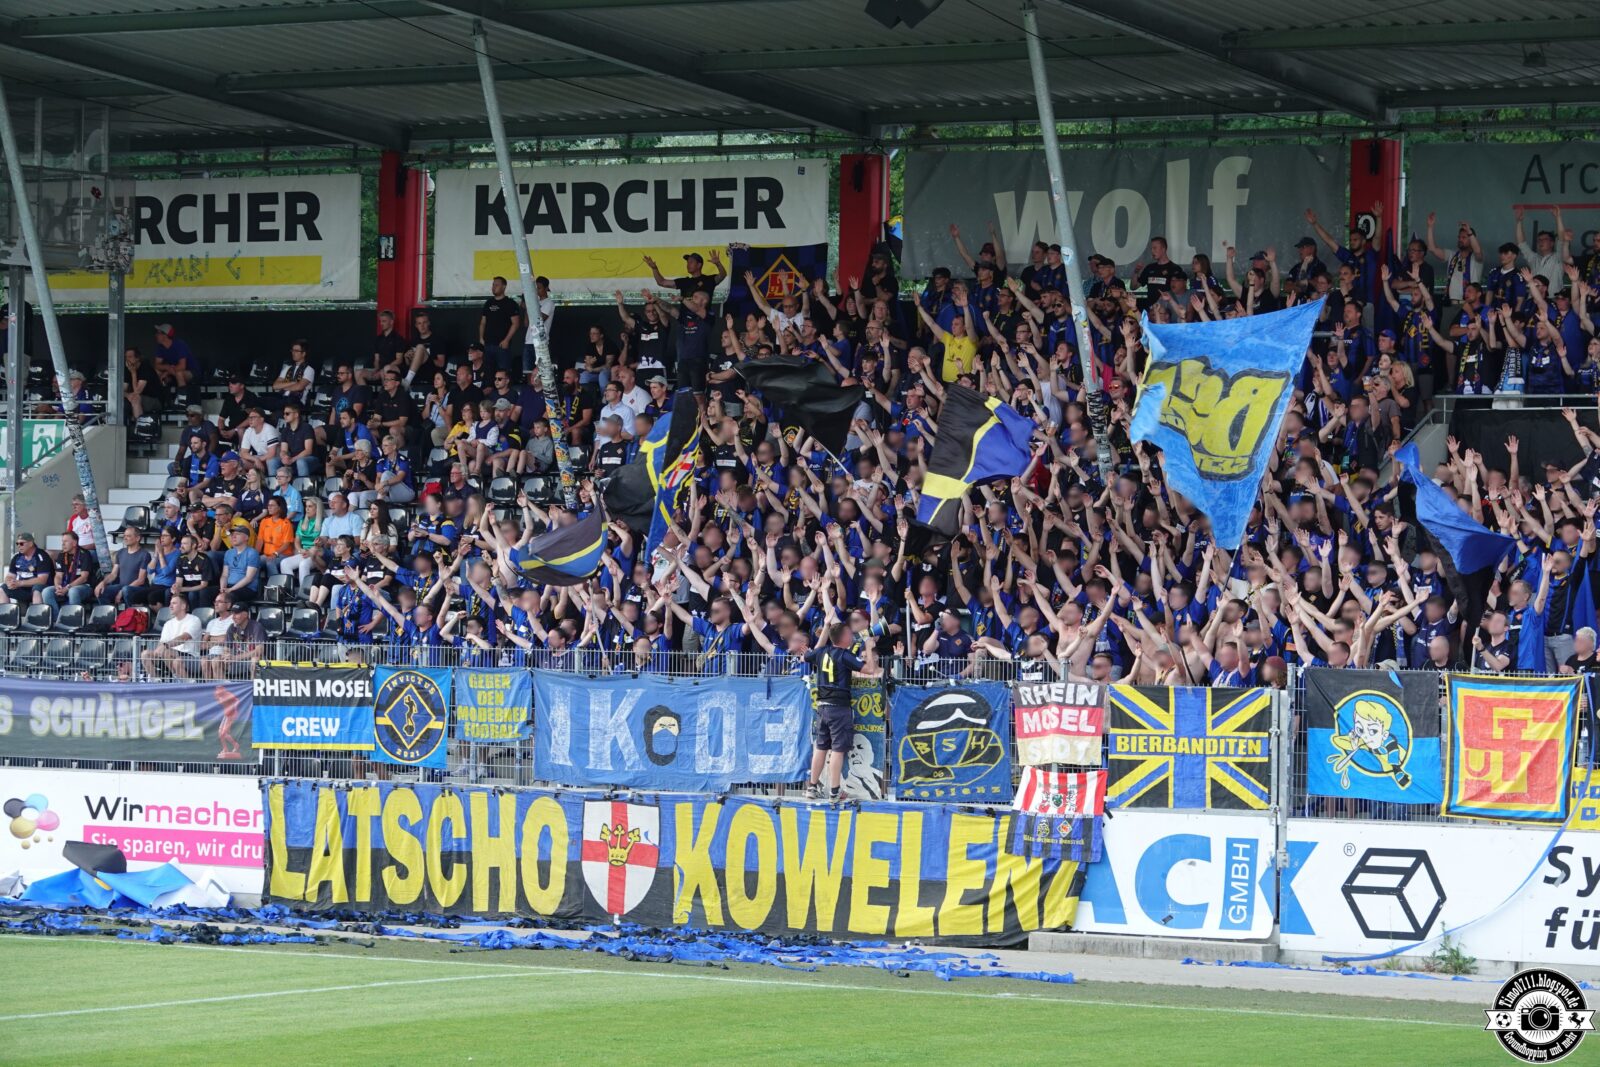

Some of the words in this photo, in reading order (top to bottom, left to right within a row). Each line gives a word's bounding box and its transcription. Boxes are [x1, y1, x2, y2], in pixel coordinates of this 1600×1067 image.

[475, 176, 786, 236] KÄRCHER
[993, 156, 1252, 265] wolf
[822, 652, 834, 682] 4
[254, 678, 310, 698] RHEIN
[315, 679, 372, 699] MOSEL
[386, 674, 436, 695] INVICTUS
[1019, 683, 1099, 706] RHEIN
[477, 690, 504, 706] DEN
[29, 692, 204, 741] SCHÄNGEL
[281, 716, 340, 737] CREW
[1022, 706, 1096, 734] MOSEL
[396, 748, 420, 759] 2021
[1116, 735, 1262, 755] BIERBANDITEN
[123, 838, 190, 858] sparen,
[196, 839, 226, 858] wir
[269, 783, 568, 916] LATSCHO
[1228, 842, 1251, 925] GMBH
